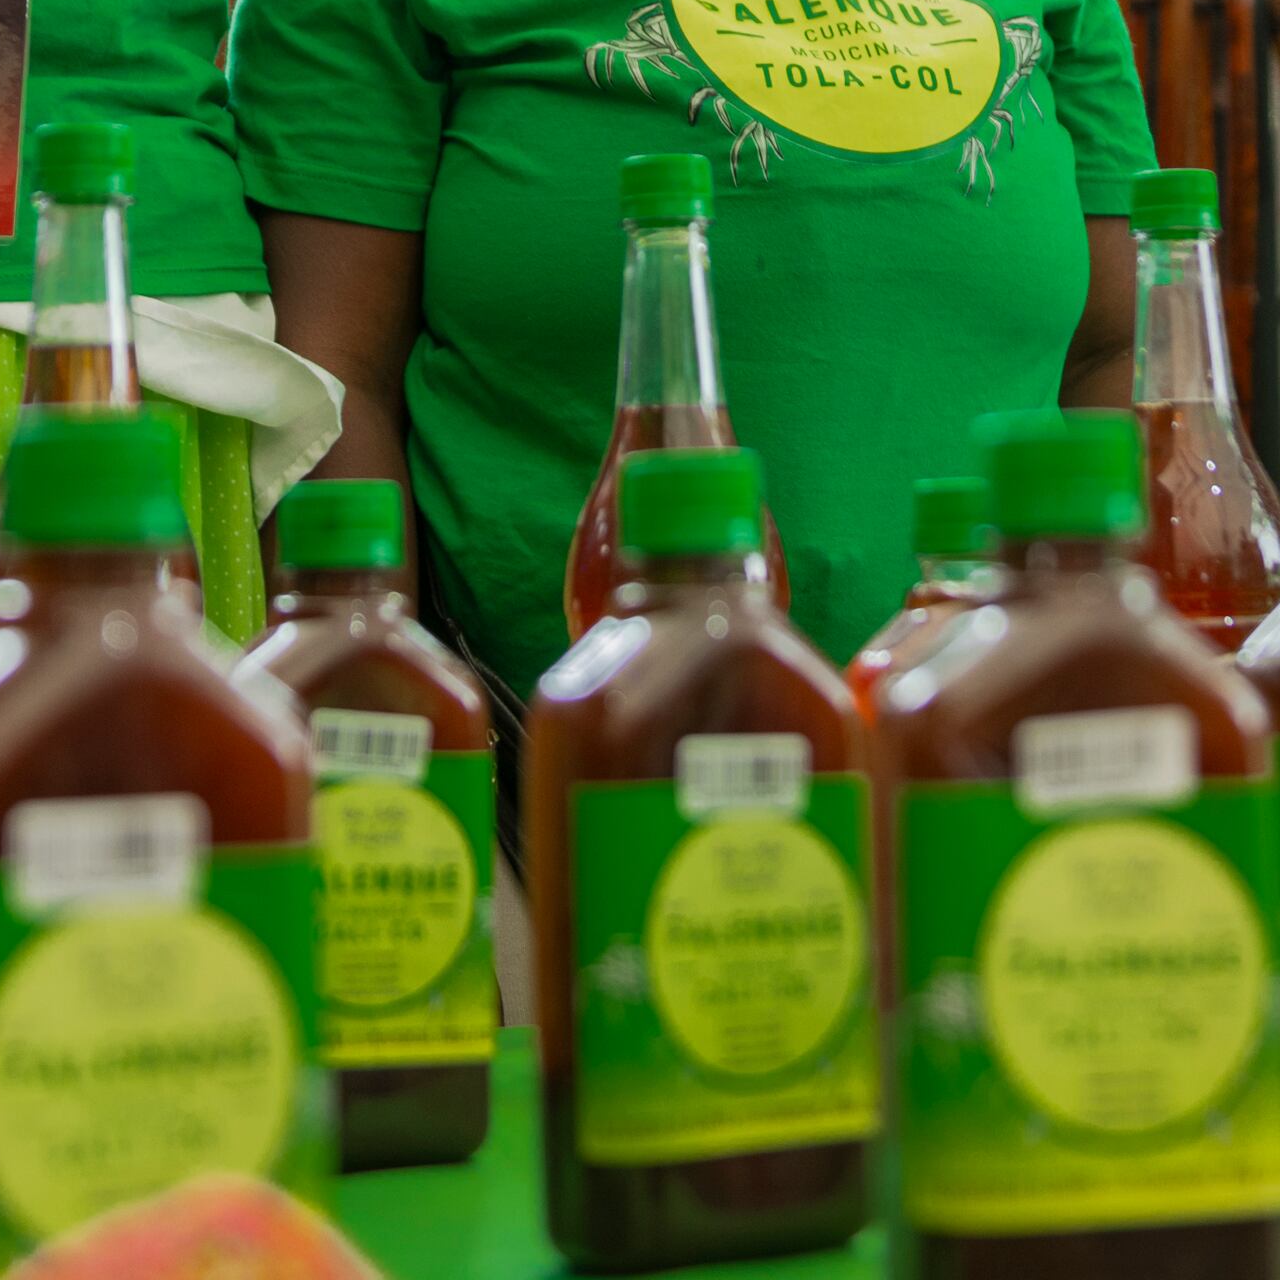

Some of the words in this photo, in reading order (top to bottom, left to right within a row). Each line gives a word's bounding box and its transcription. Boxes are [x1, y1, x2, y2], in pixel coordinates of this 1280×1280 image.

[803, 19, 882, 43] CURAO
[790, 41, 919, 62] MEDICINAL
[756, 62, 963, 96] TOLA-COL
